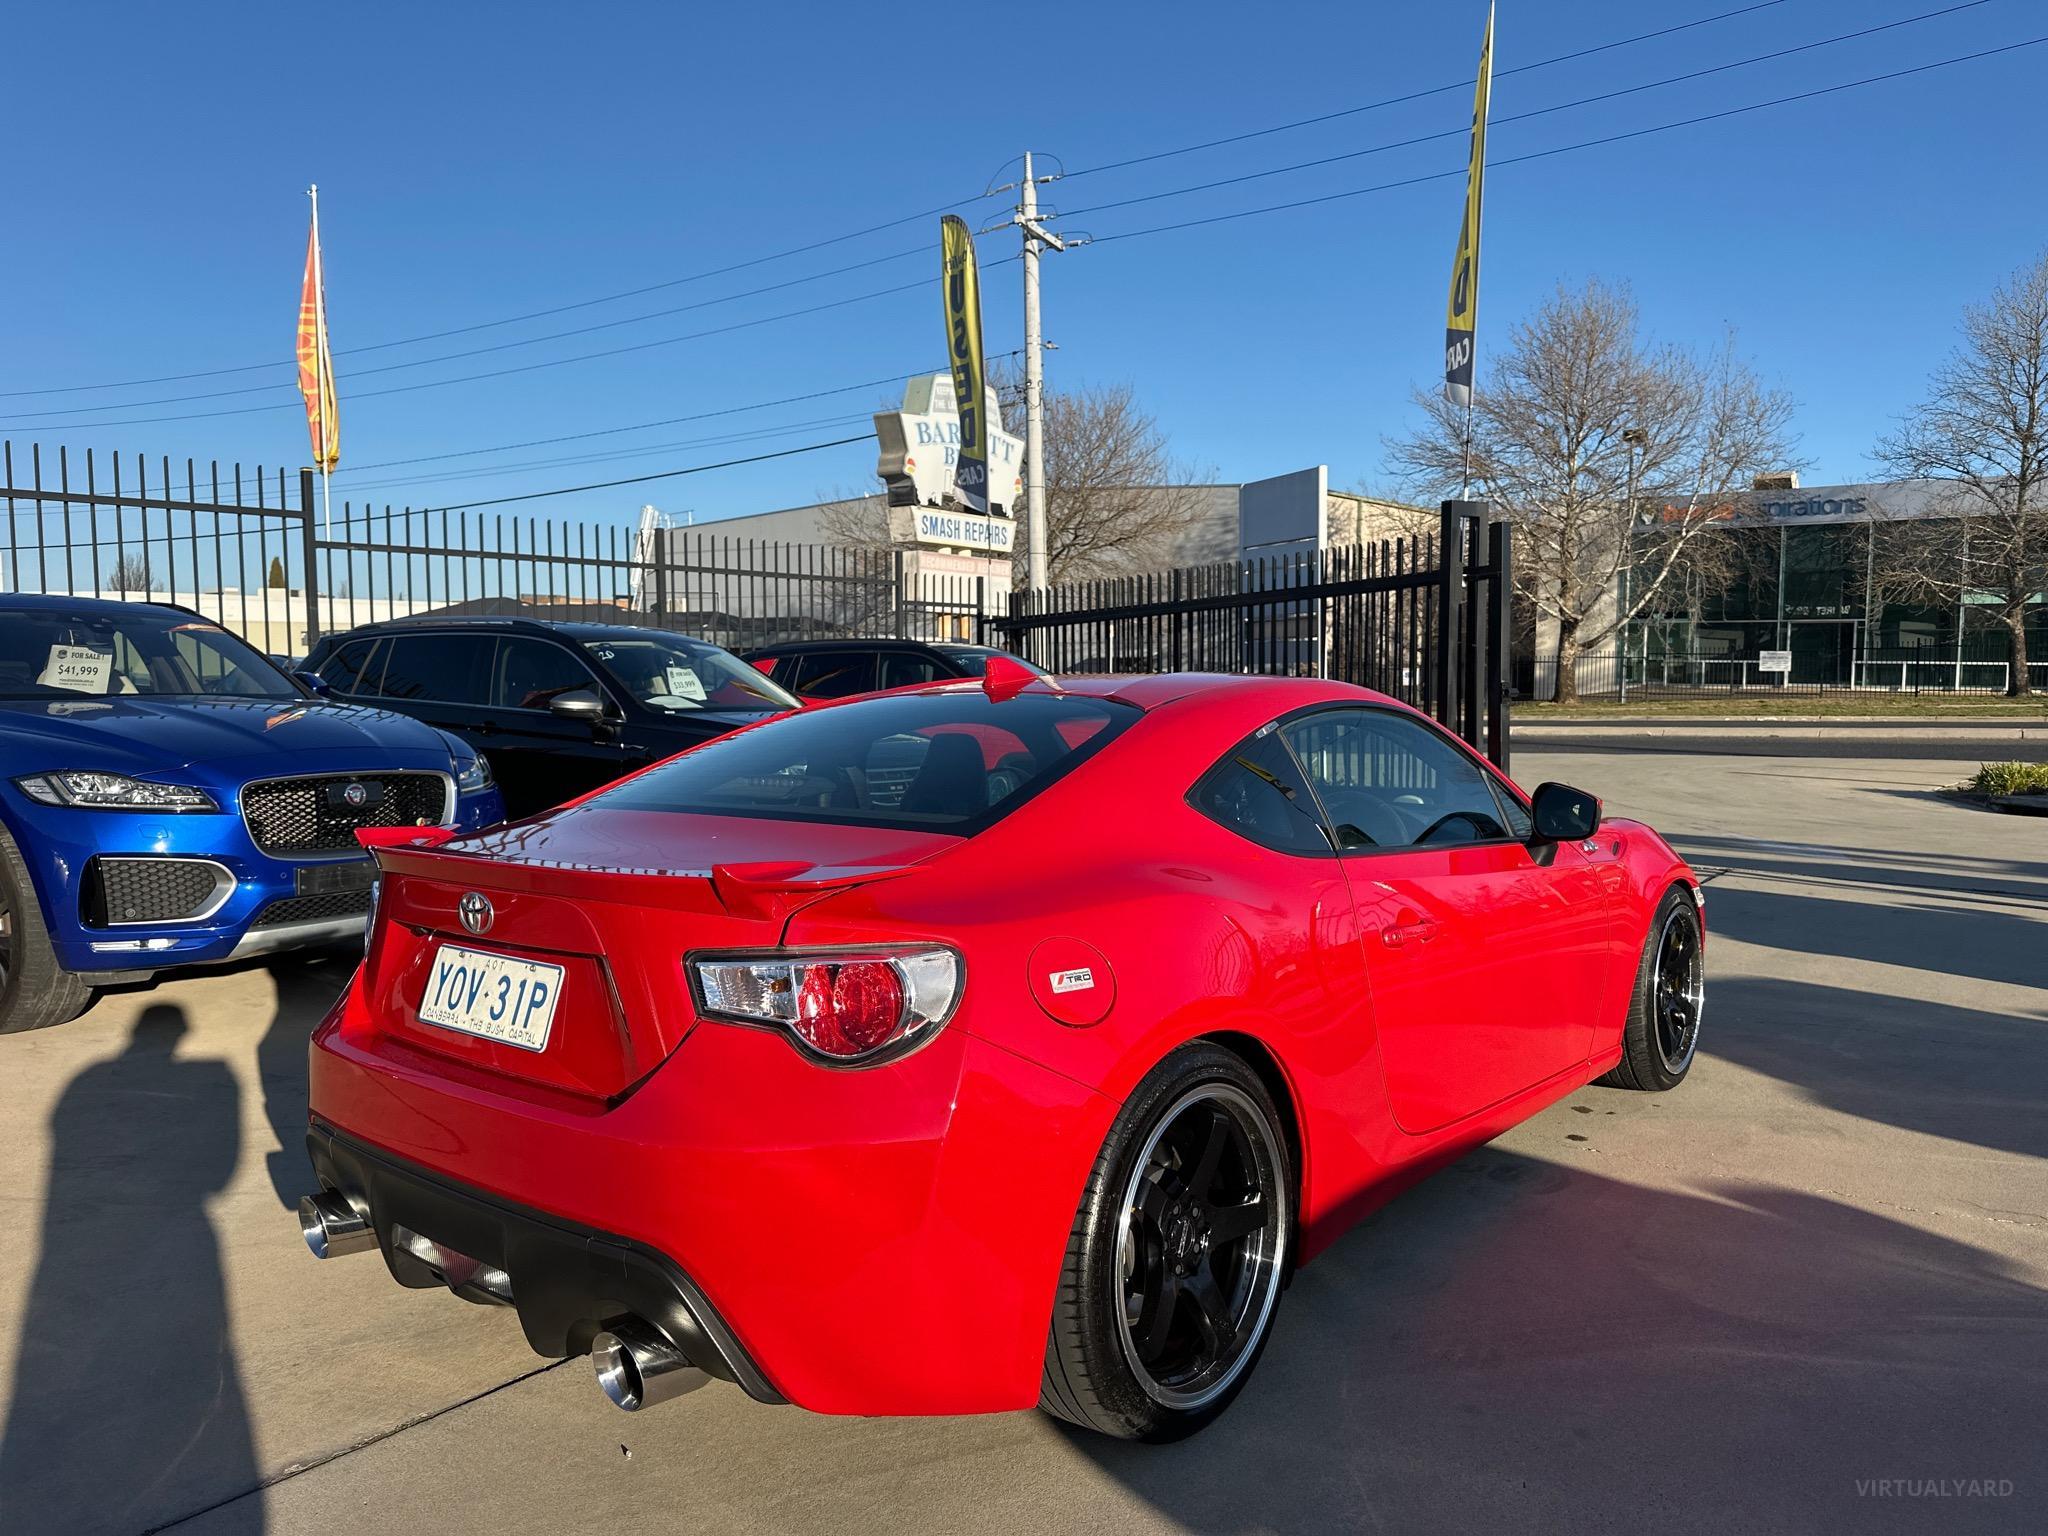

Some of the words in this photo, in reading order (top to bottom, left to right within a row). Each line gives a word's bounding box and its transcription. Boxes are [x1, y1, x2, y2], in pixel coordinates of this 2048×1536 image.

[915, 420, 1014, 461] BARTT
[921, 514, 960, 540] SMASH
[965, 521, 1007, 545] REPAIRS
[58, 664, 98, 676] $41,999
[1065, 973, 1091, 983] TRD
[426, 1007, 459, 1024] CANBERRA
[469, 1018, 483, 1030] THE
[486, 1022, 506, 1036] BUSH
[508, 1028, 536, 1045] CAPITAL
